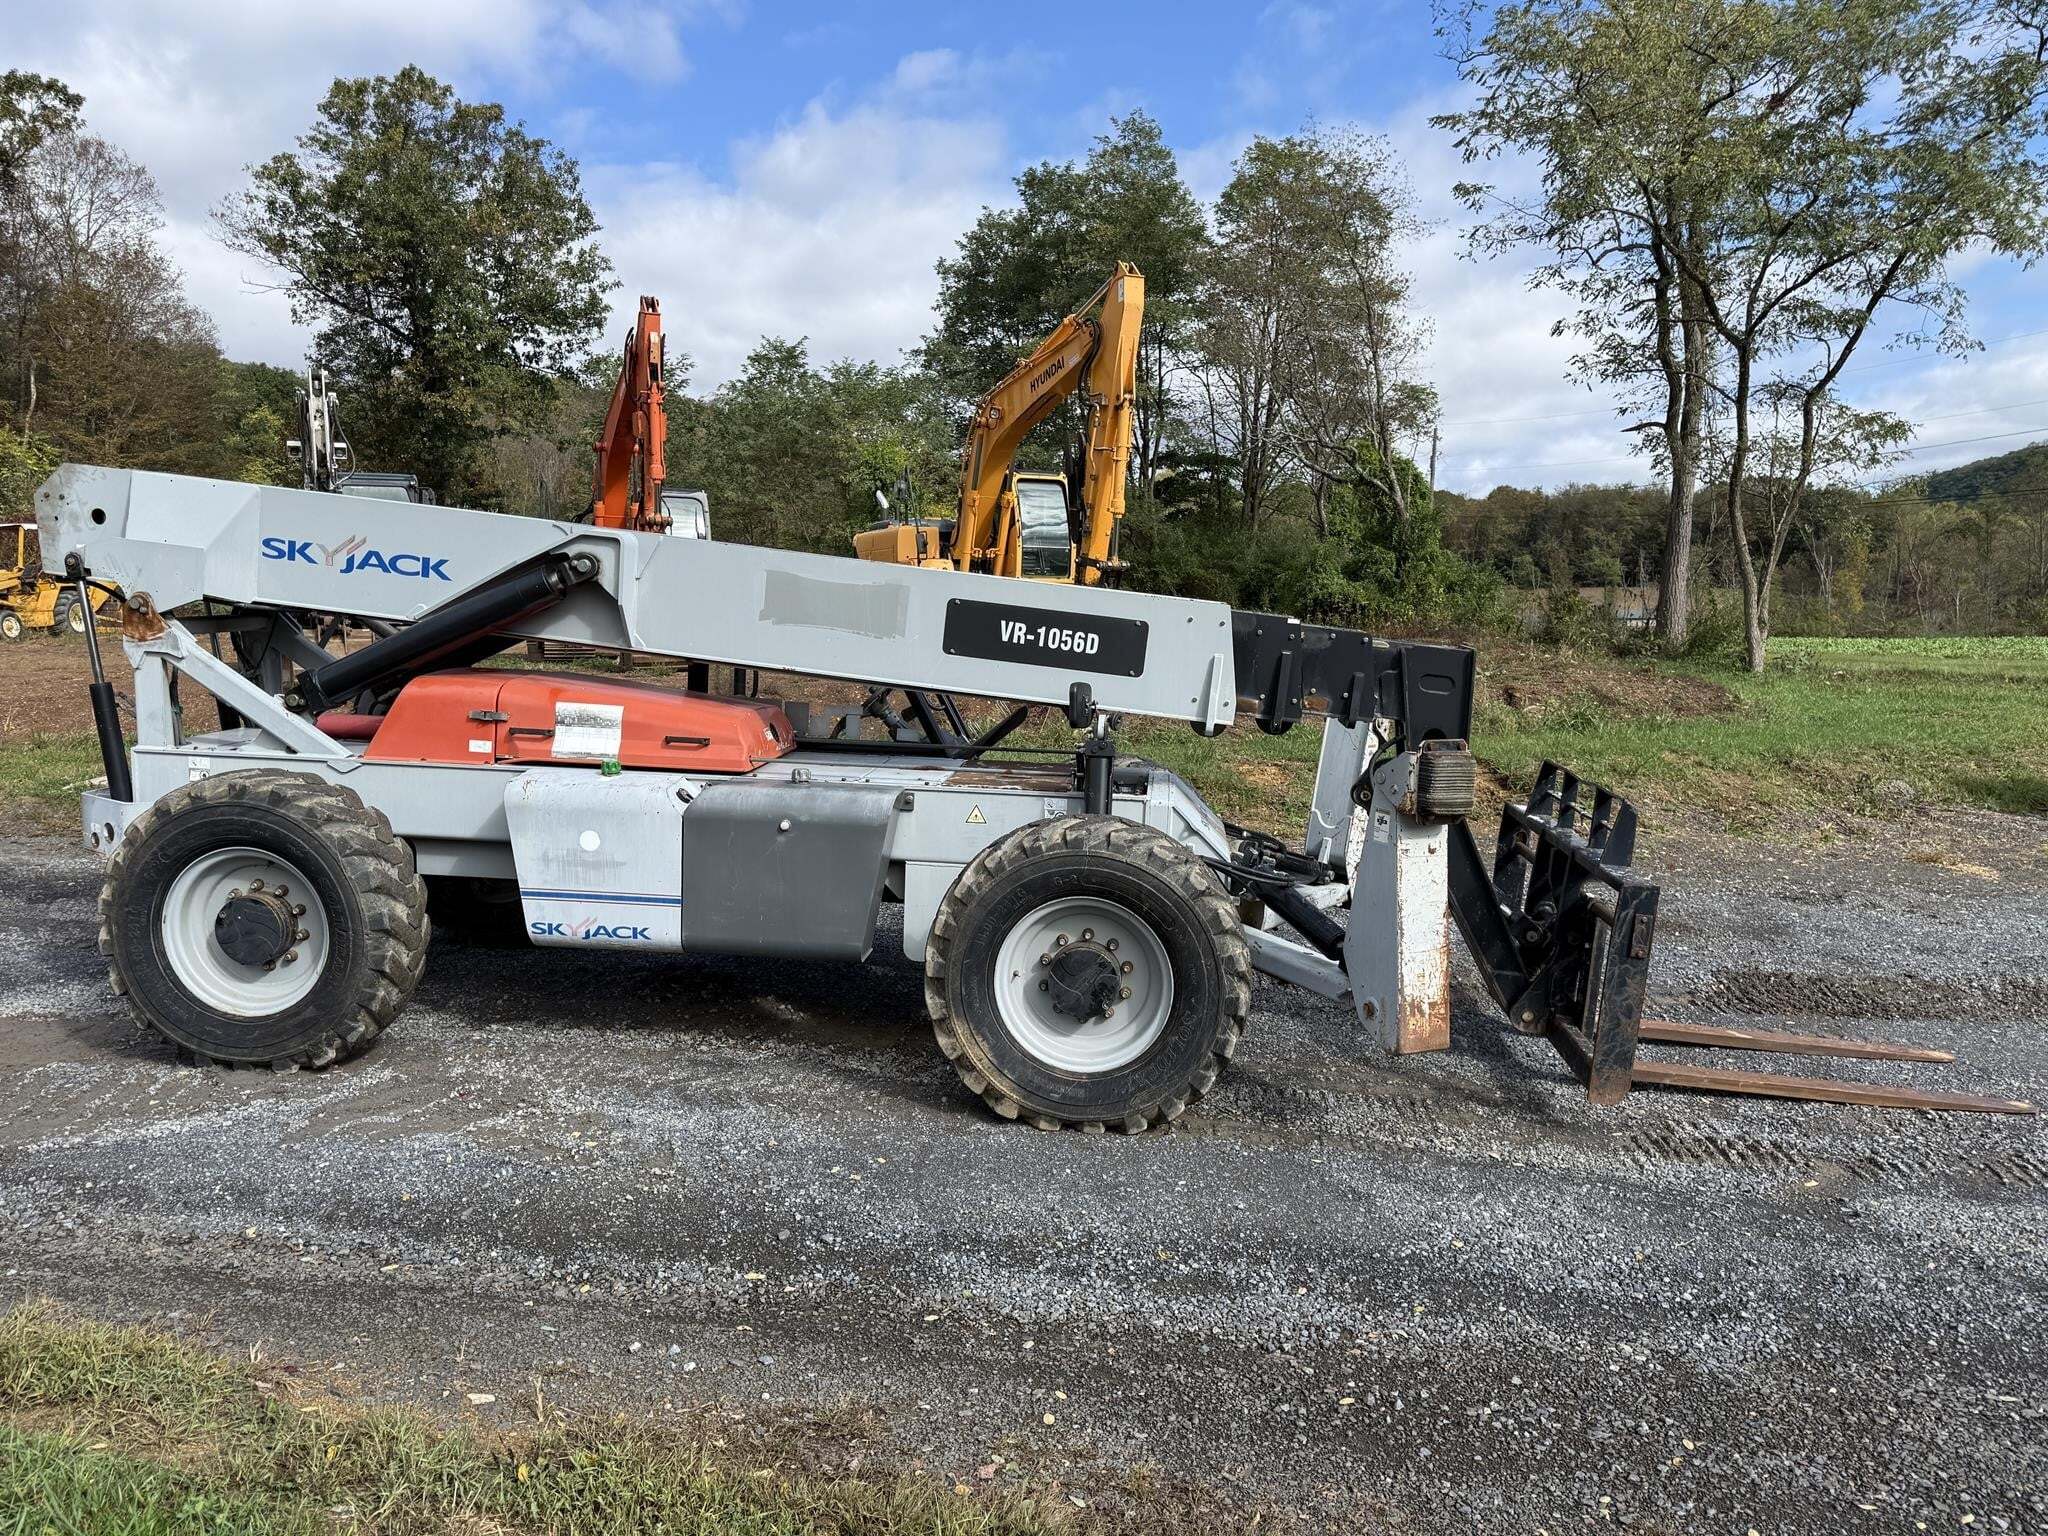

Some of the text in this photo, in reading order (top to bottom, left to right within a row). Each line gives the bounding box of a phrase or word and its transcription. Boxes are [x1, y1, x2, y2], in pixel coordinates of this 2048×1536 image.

[1030, 356, 1065, 392] HYUNDAI
[261, 534, 453, 581] SKYJACK
[1000, 619, 1099, 655] VR-1056D
[530, 917, 651, 940] SKYJACK
